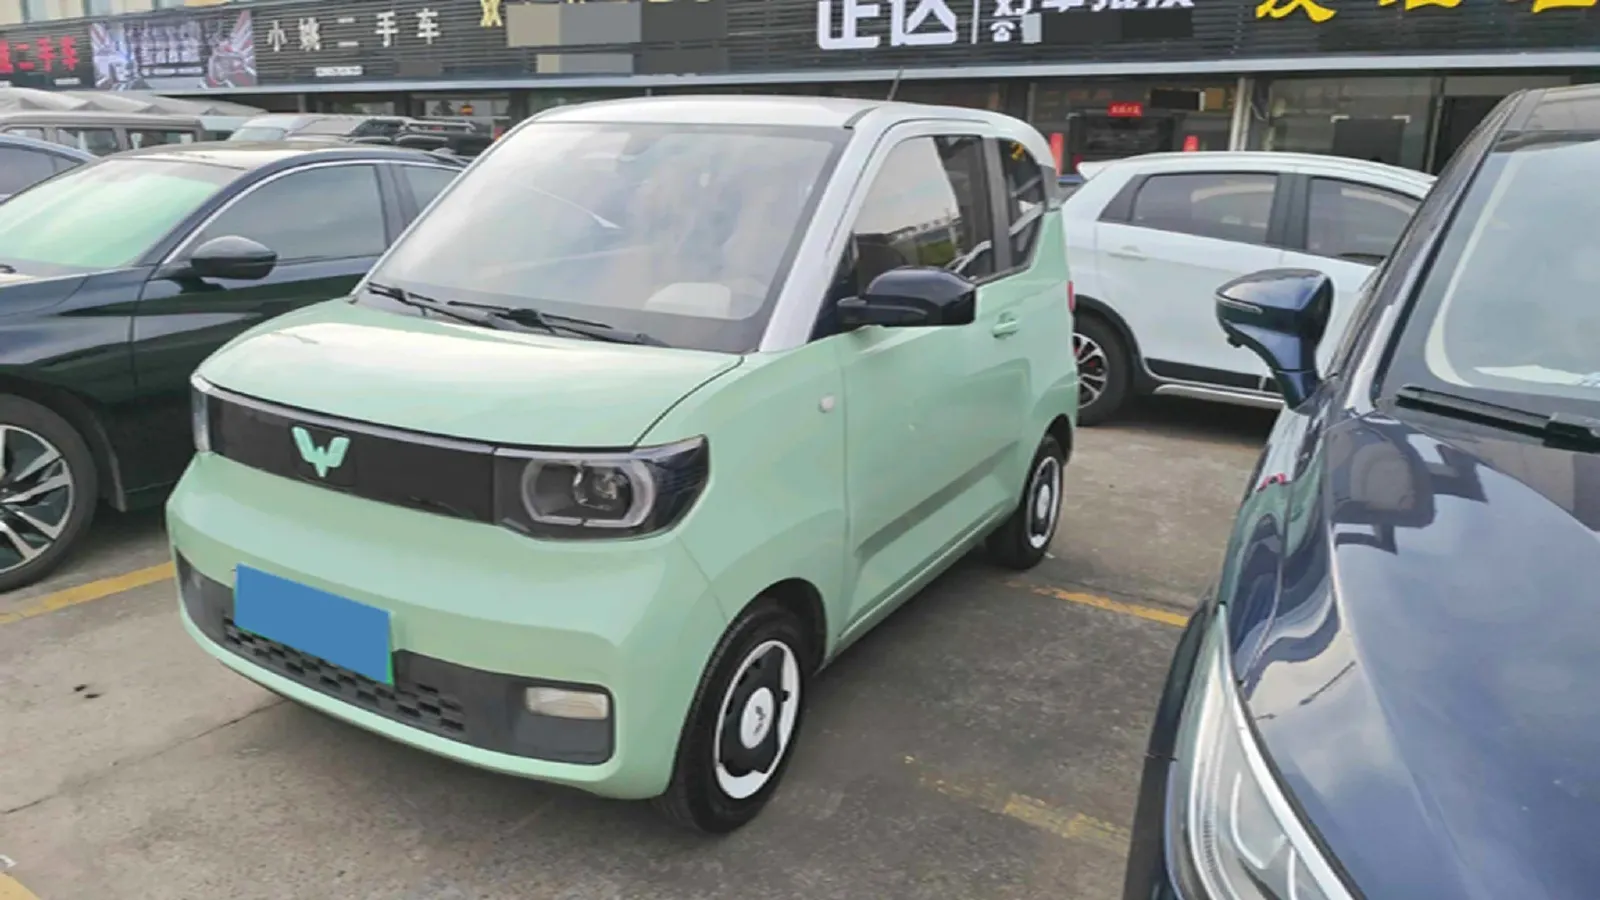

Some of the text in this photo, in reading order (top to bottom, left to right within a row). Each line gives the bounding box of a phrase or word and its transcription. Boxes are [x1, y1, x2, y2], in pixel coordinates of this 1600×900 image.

[267, 8, 441, 51] 小姚二手车
